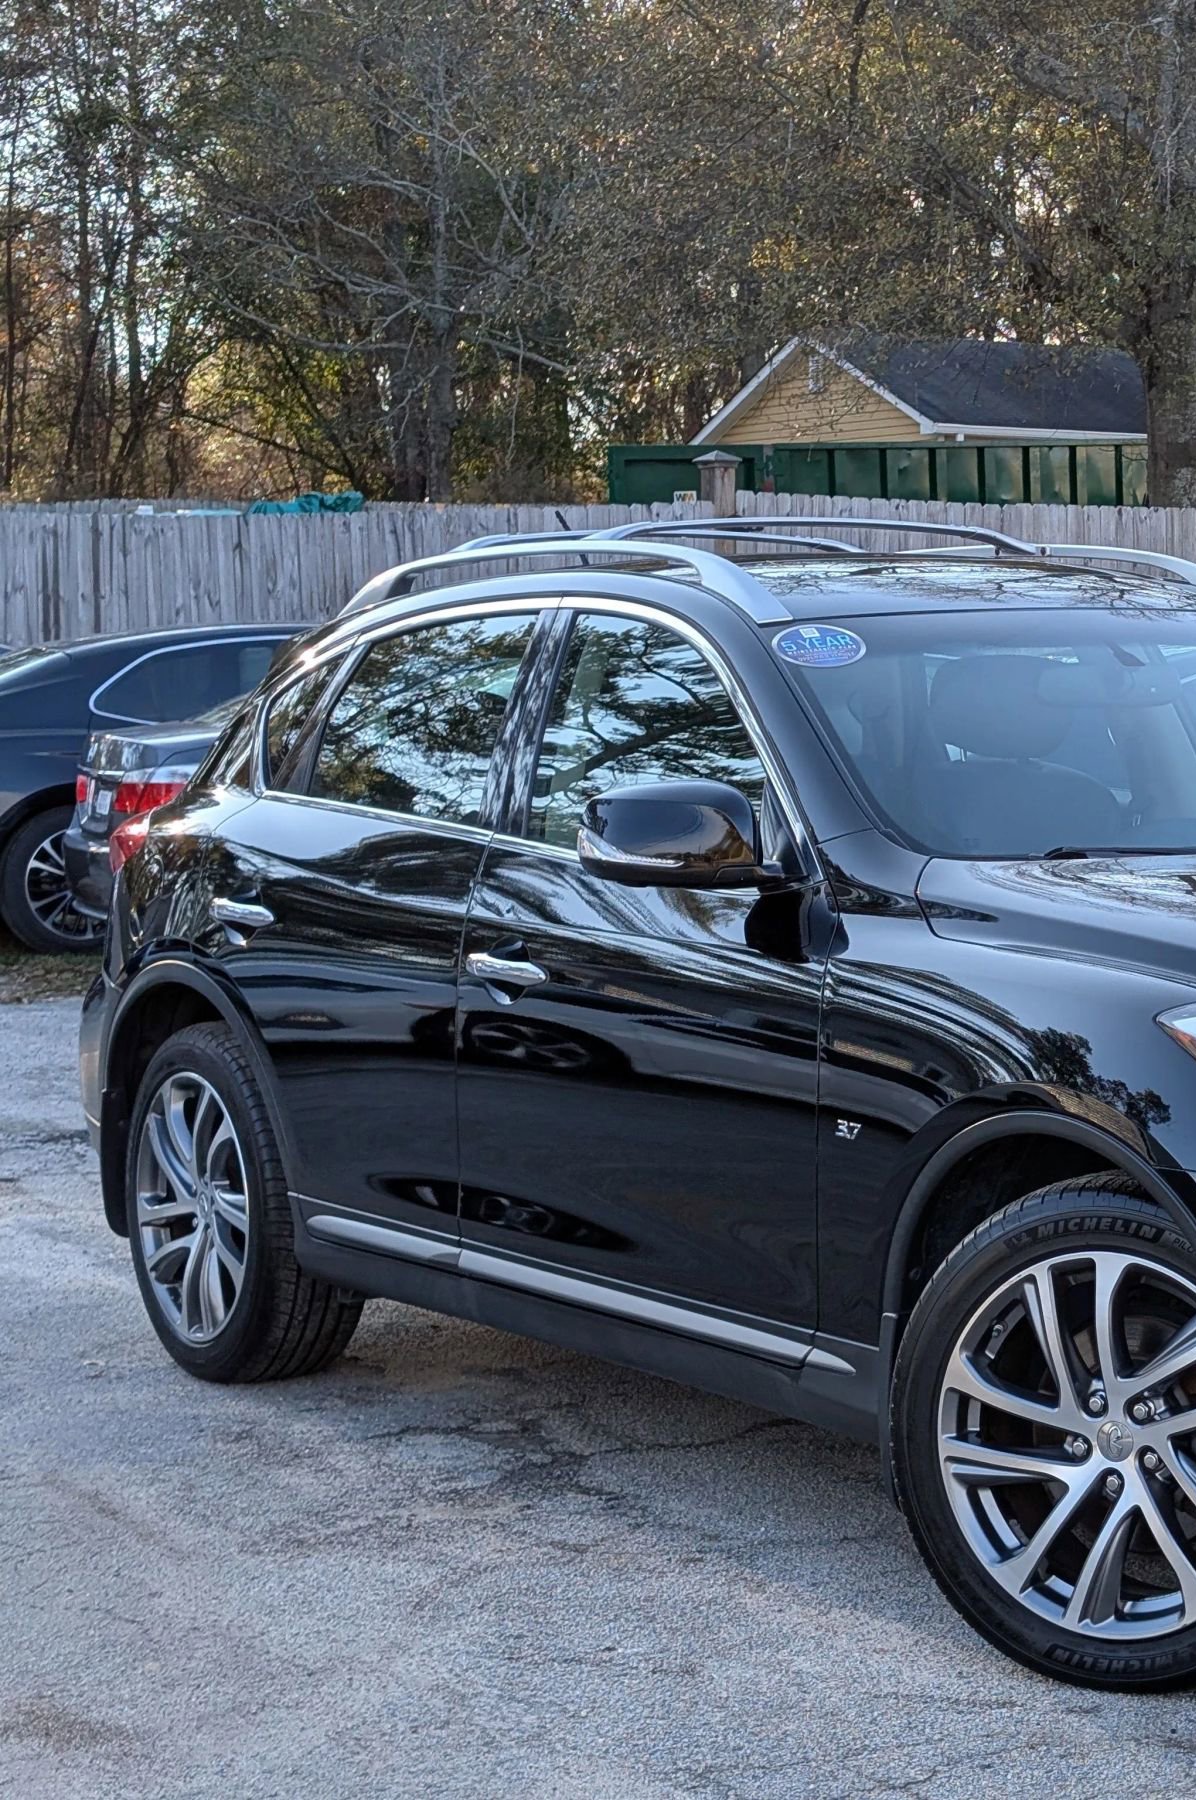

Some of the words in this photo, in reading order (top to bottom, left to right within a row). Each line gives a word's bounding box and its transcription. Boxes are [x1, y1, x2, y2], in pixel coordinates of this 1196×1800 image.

[780, 640, 797, 652] 5
[796, 635, 854, 649] YEAR
[1038, 1217, 1157, 1239] MICHELIN
[1051, 1648, 1172, 1673] MICHELIN
